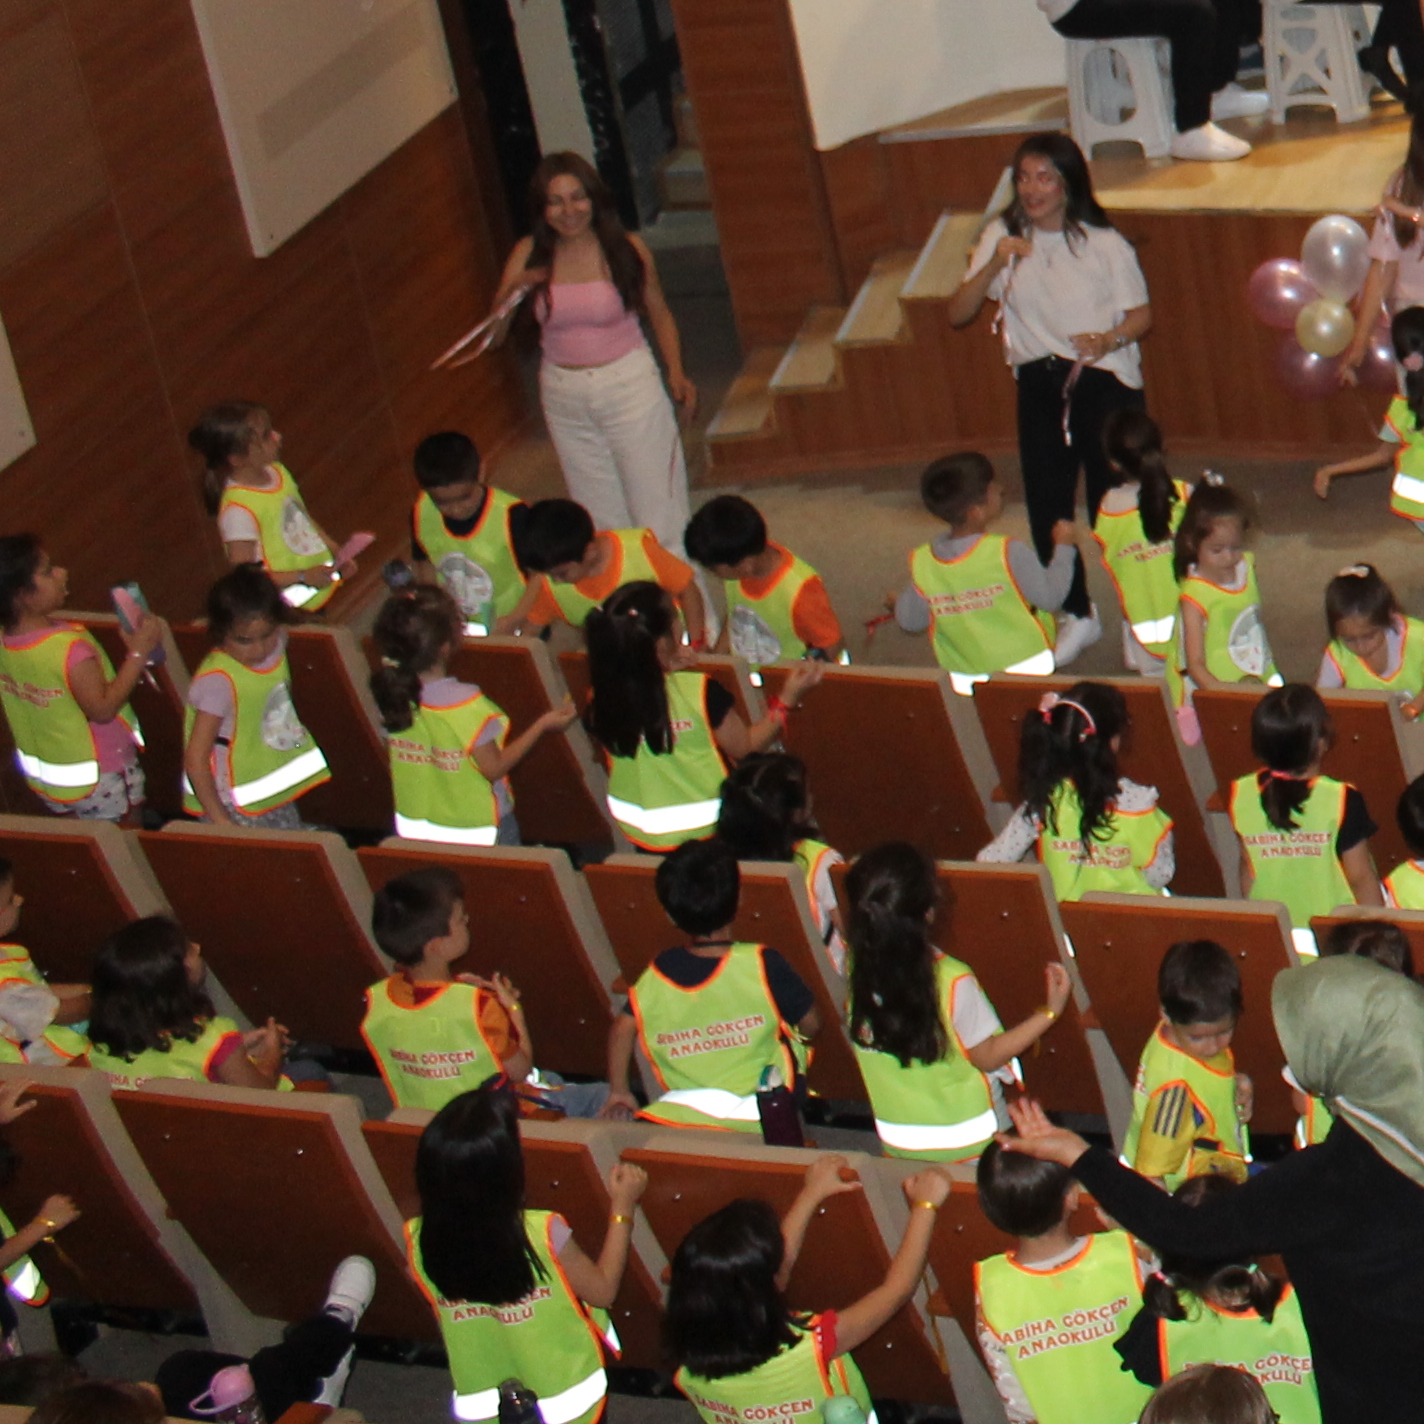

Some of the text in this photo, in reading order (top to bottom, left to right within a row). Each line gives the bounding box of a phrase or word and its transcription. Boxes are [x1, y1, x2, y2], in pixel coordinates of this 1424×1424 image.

[1000, 1293, 1129, 1345] ABİHA GÖKÇEN
[1017, 1321, 1118, 1361] ANAOKULU
[1254, 1353, 1312, 1373] GÖKÇE
